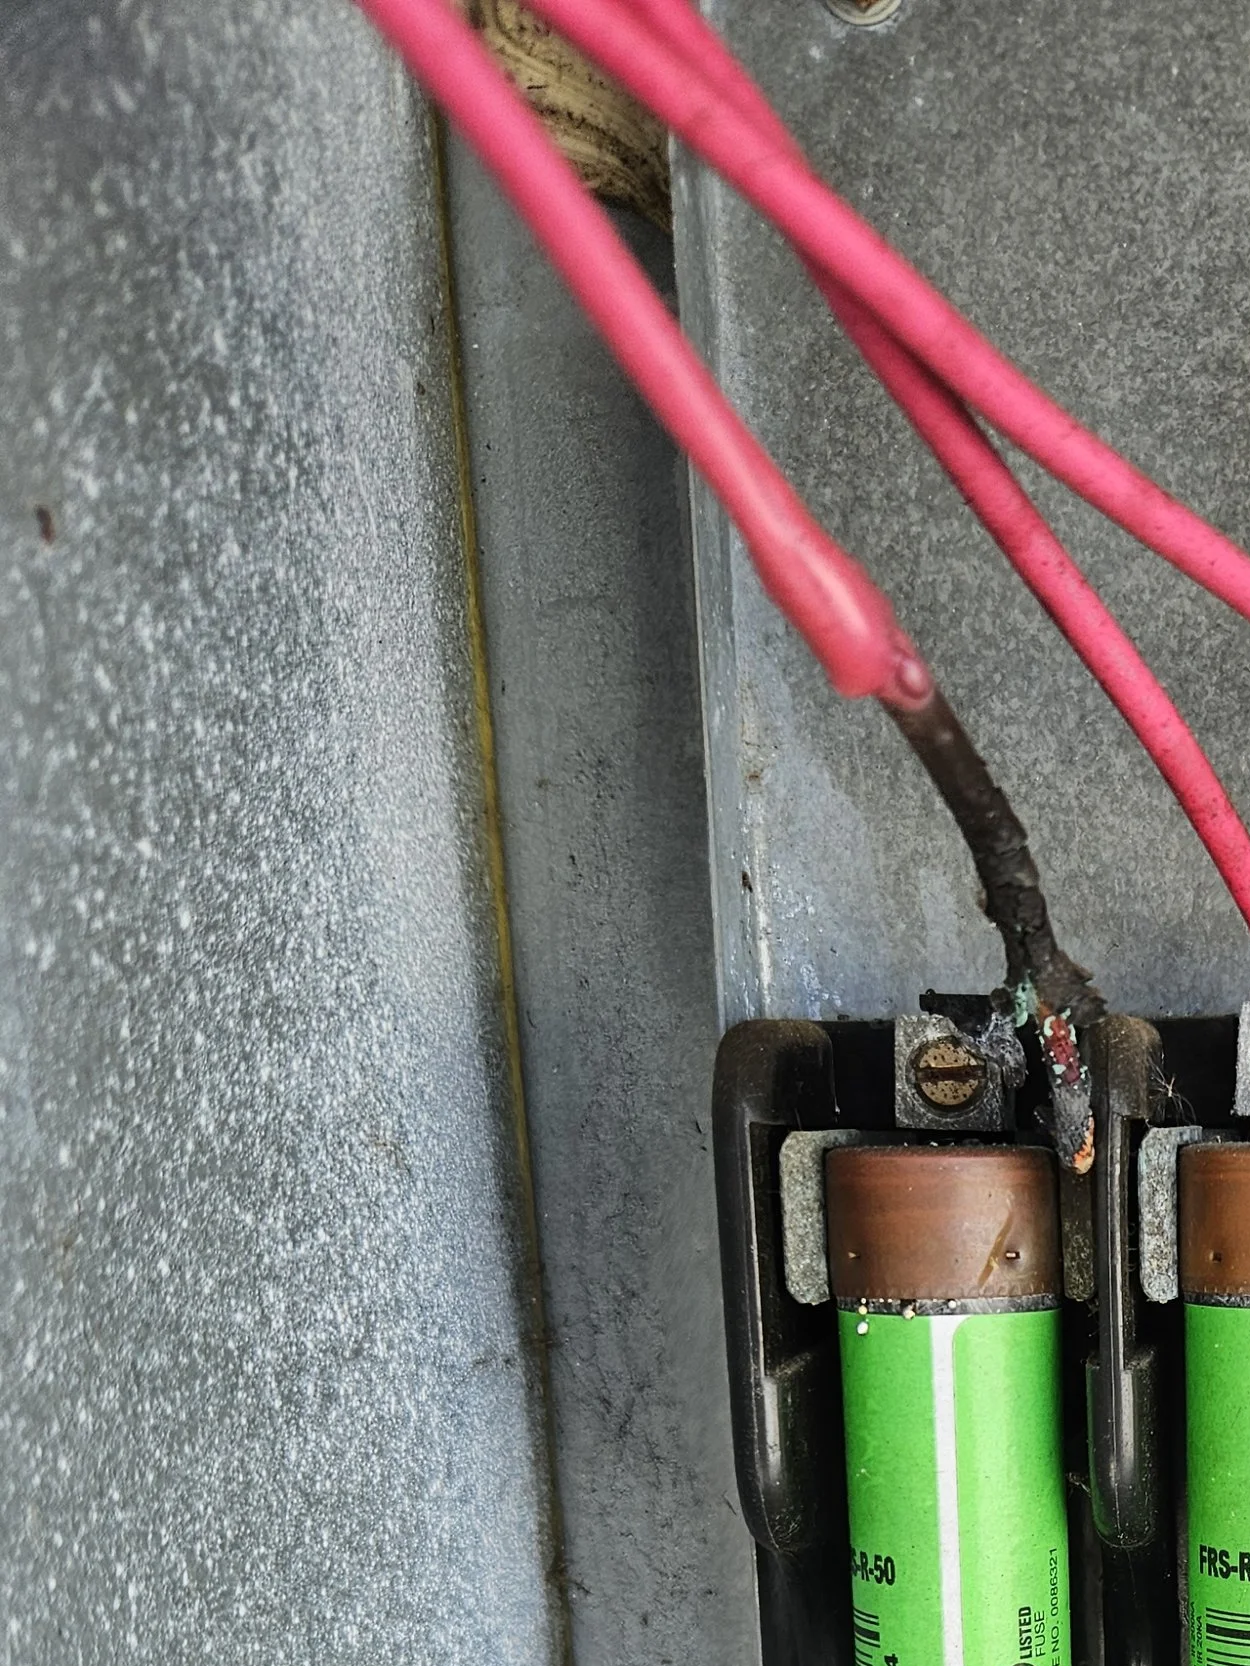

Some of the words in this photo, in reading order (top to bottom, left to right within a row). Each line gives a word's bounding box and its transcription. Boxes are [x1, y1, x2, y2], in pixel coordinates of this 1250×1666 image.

[1048, 1548, 1060, 1617] 0086321
[1018, 1606, 1032, 1660] LISTED
[1034, 1610, 1047, 1658] FUSE
[1050, 1620, 1060, 1651] NO.
